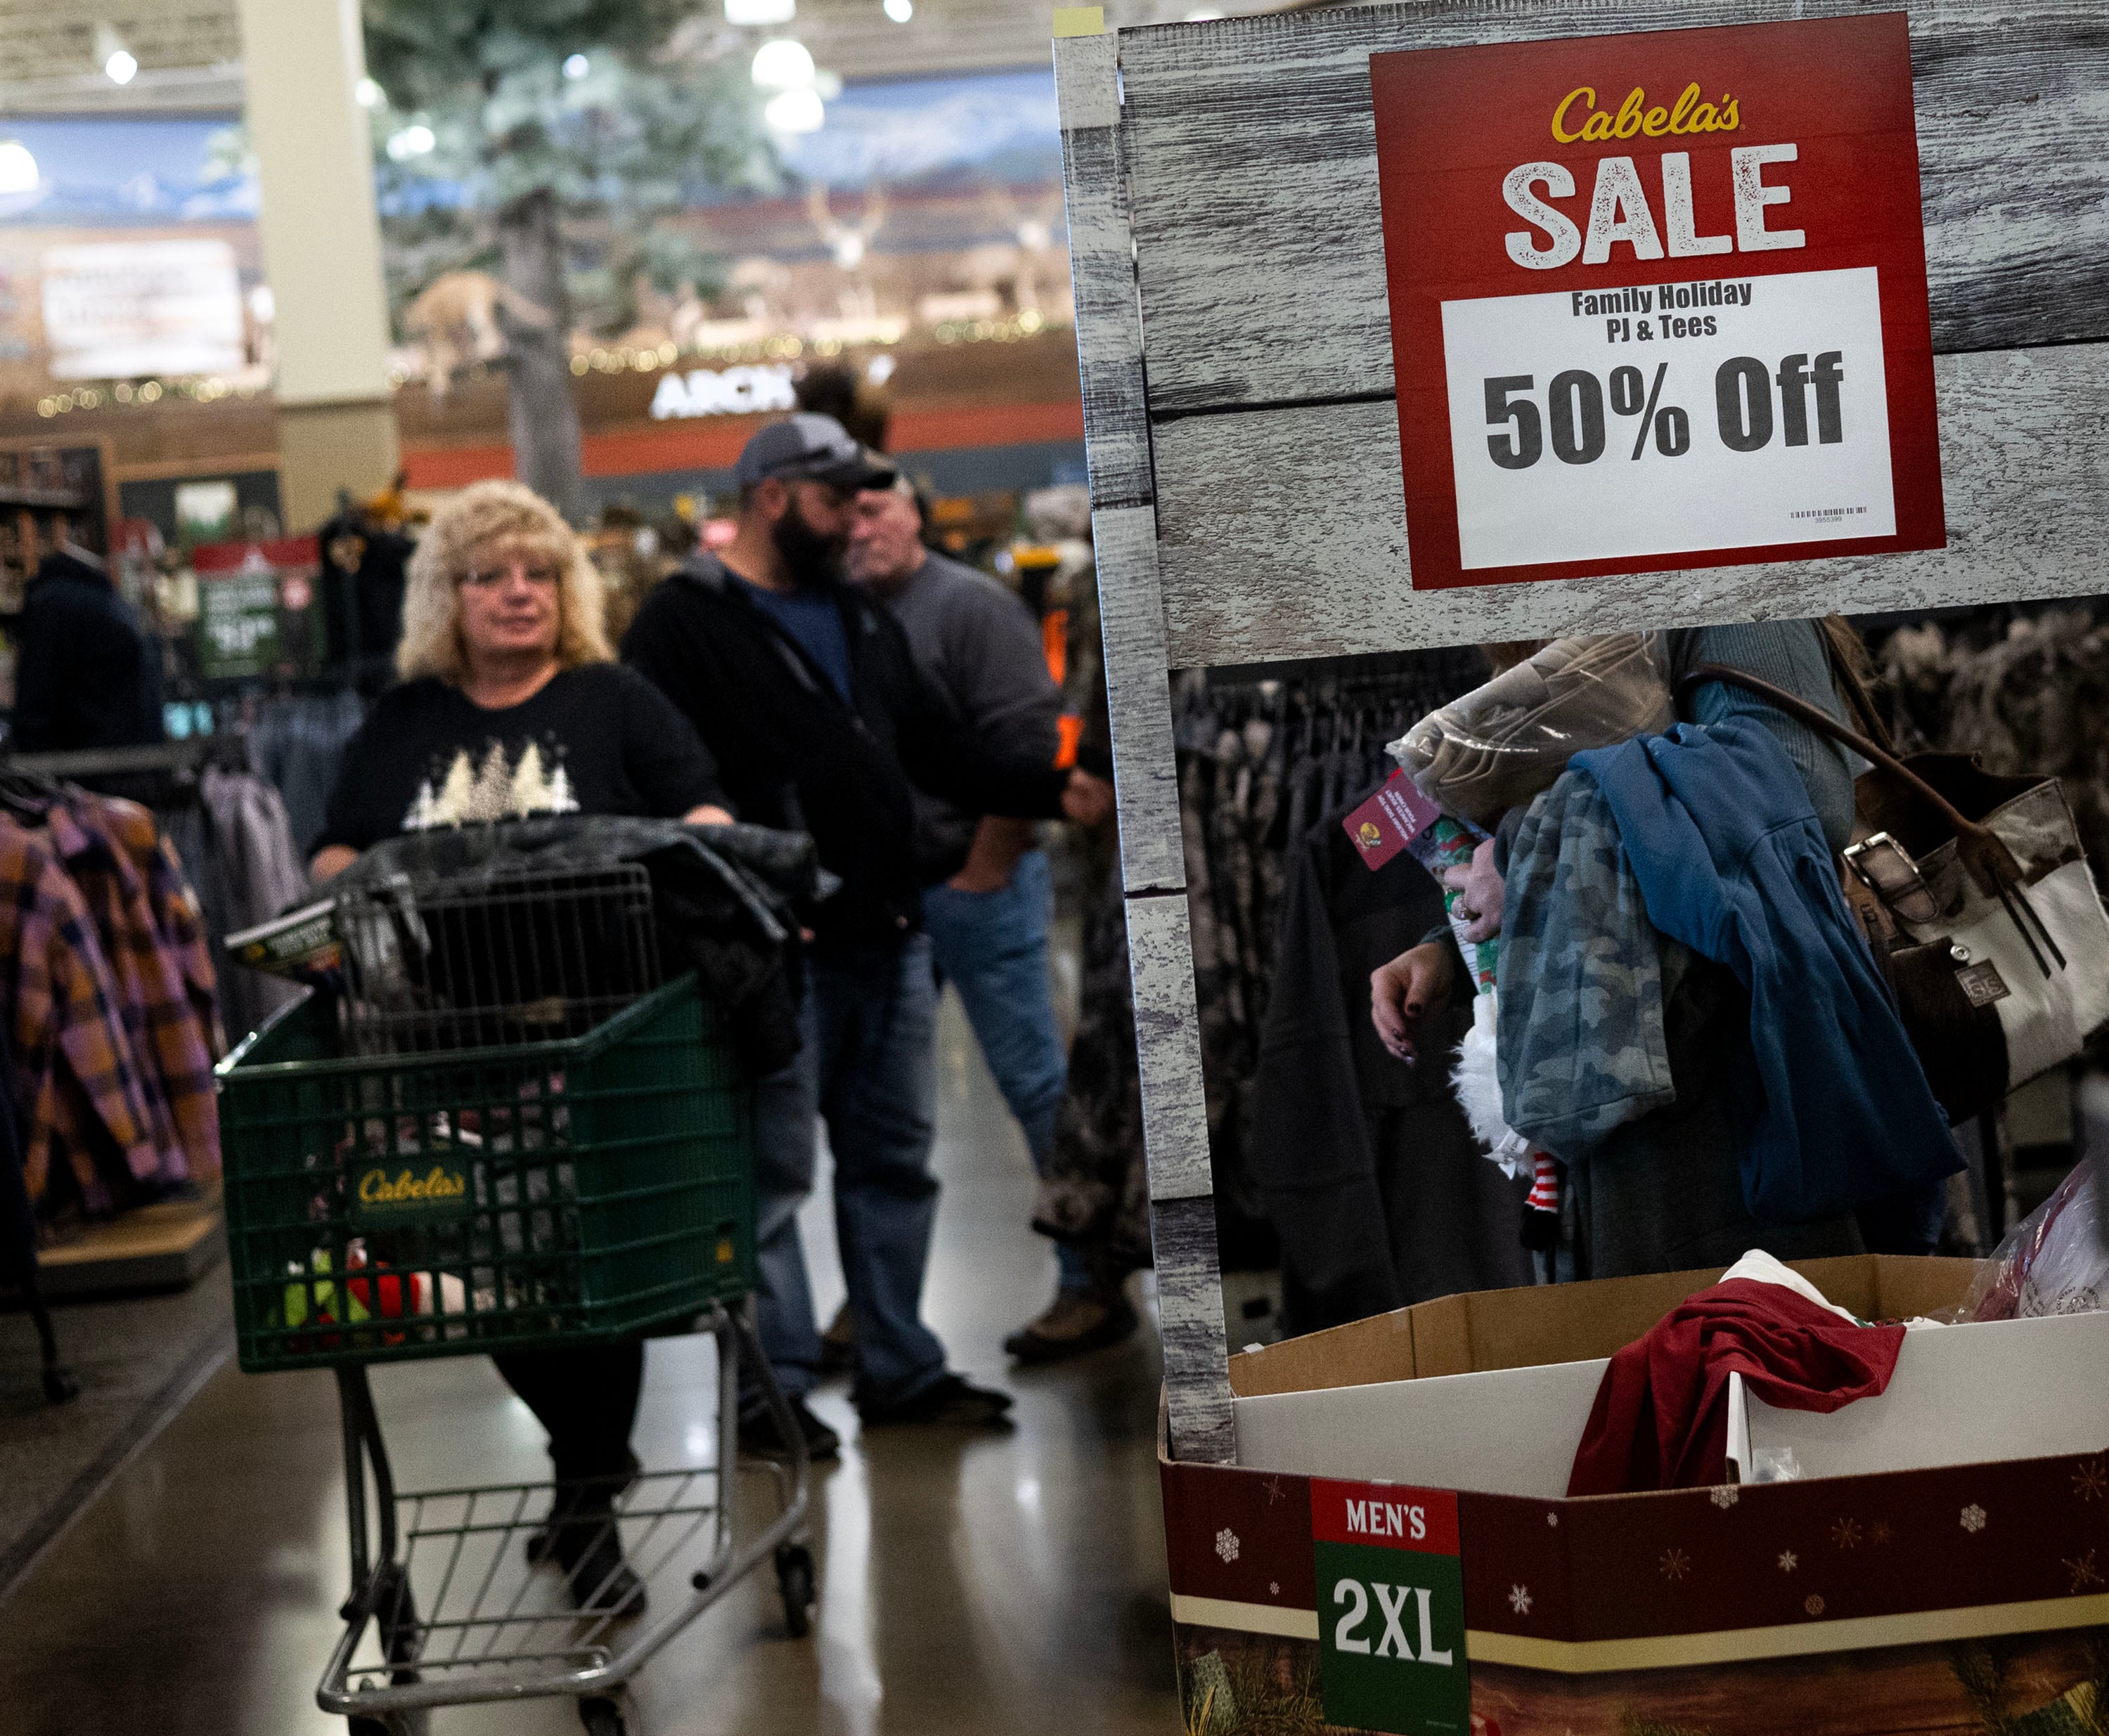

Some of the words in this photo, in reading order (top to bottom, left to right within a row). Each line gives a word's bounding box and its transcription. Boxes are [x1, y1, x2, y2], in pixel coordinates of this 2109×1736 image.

[1552, 82, 1741, 143] Cabela's
[1502, 143, 1806, 270] SALE
[1572, 287, 1652, 316] Family
[1658, 281, 1752, 309] Holiday
[1606, 318, 1630, 343] PJ
[1637, 320, 1653, 342] &
[1658, 315, 1717, 339] Tees
[1484, 362, 1691, 469] 50%
[1715, 351, 1844, 452] Off
[1346, 1498, 1426, 1539] MEN'S
[1334, 1578, 1452, 1666] 2XL
